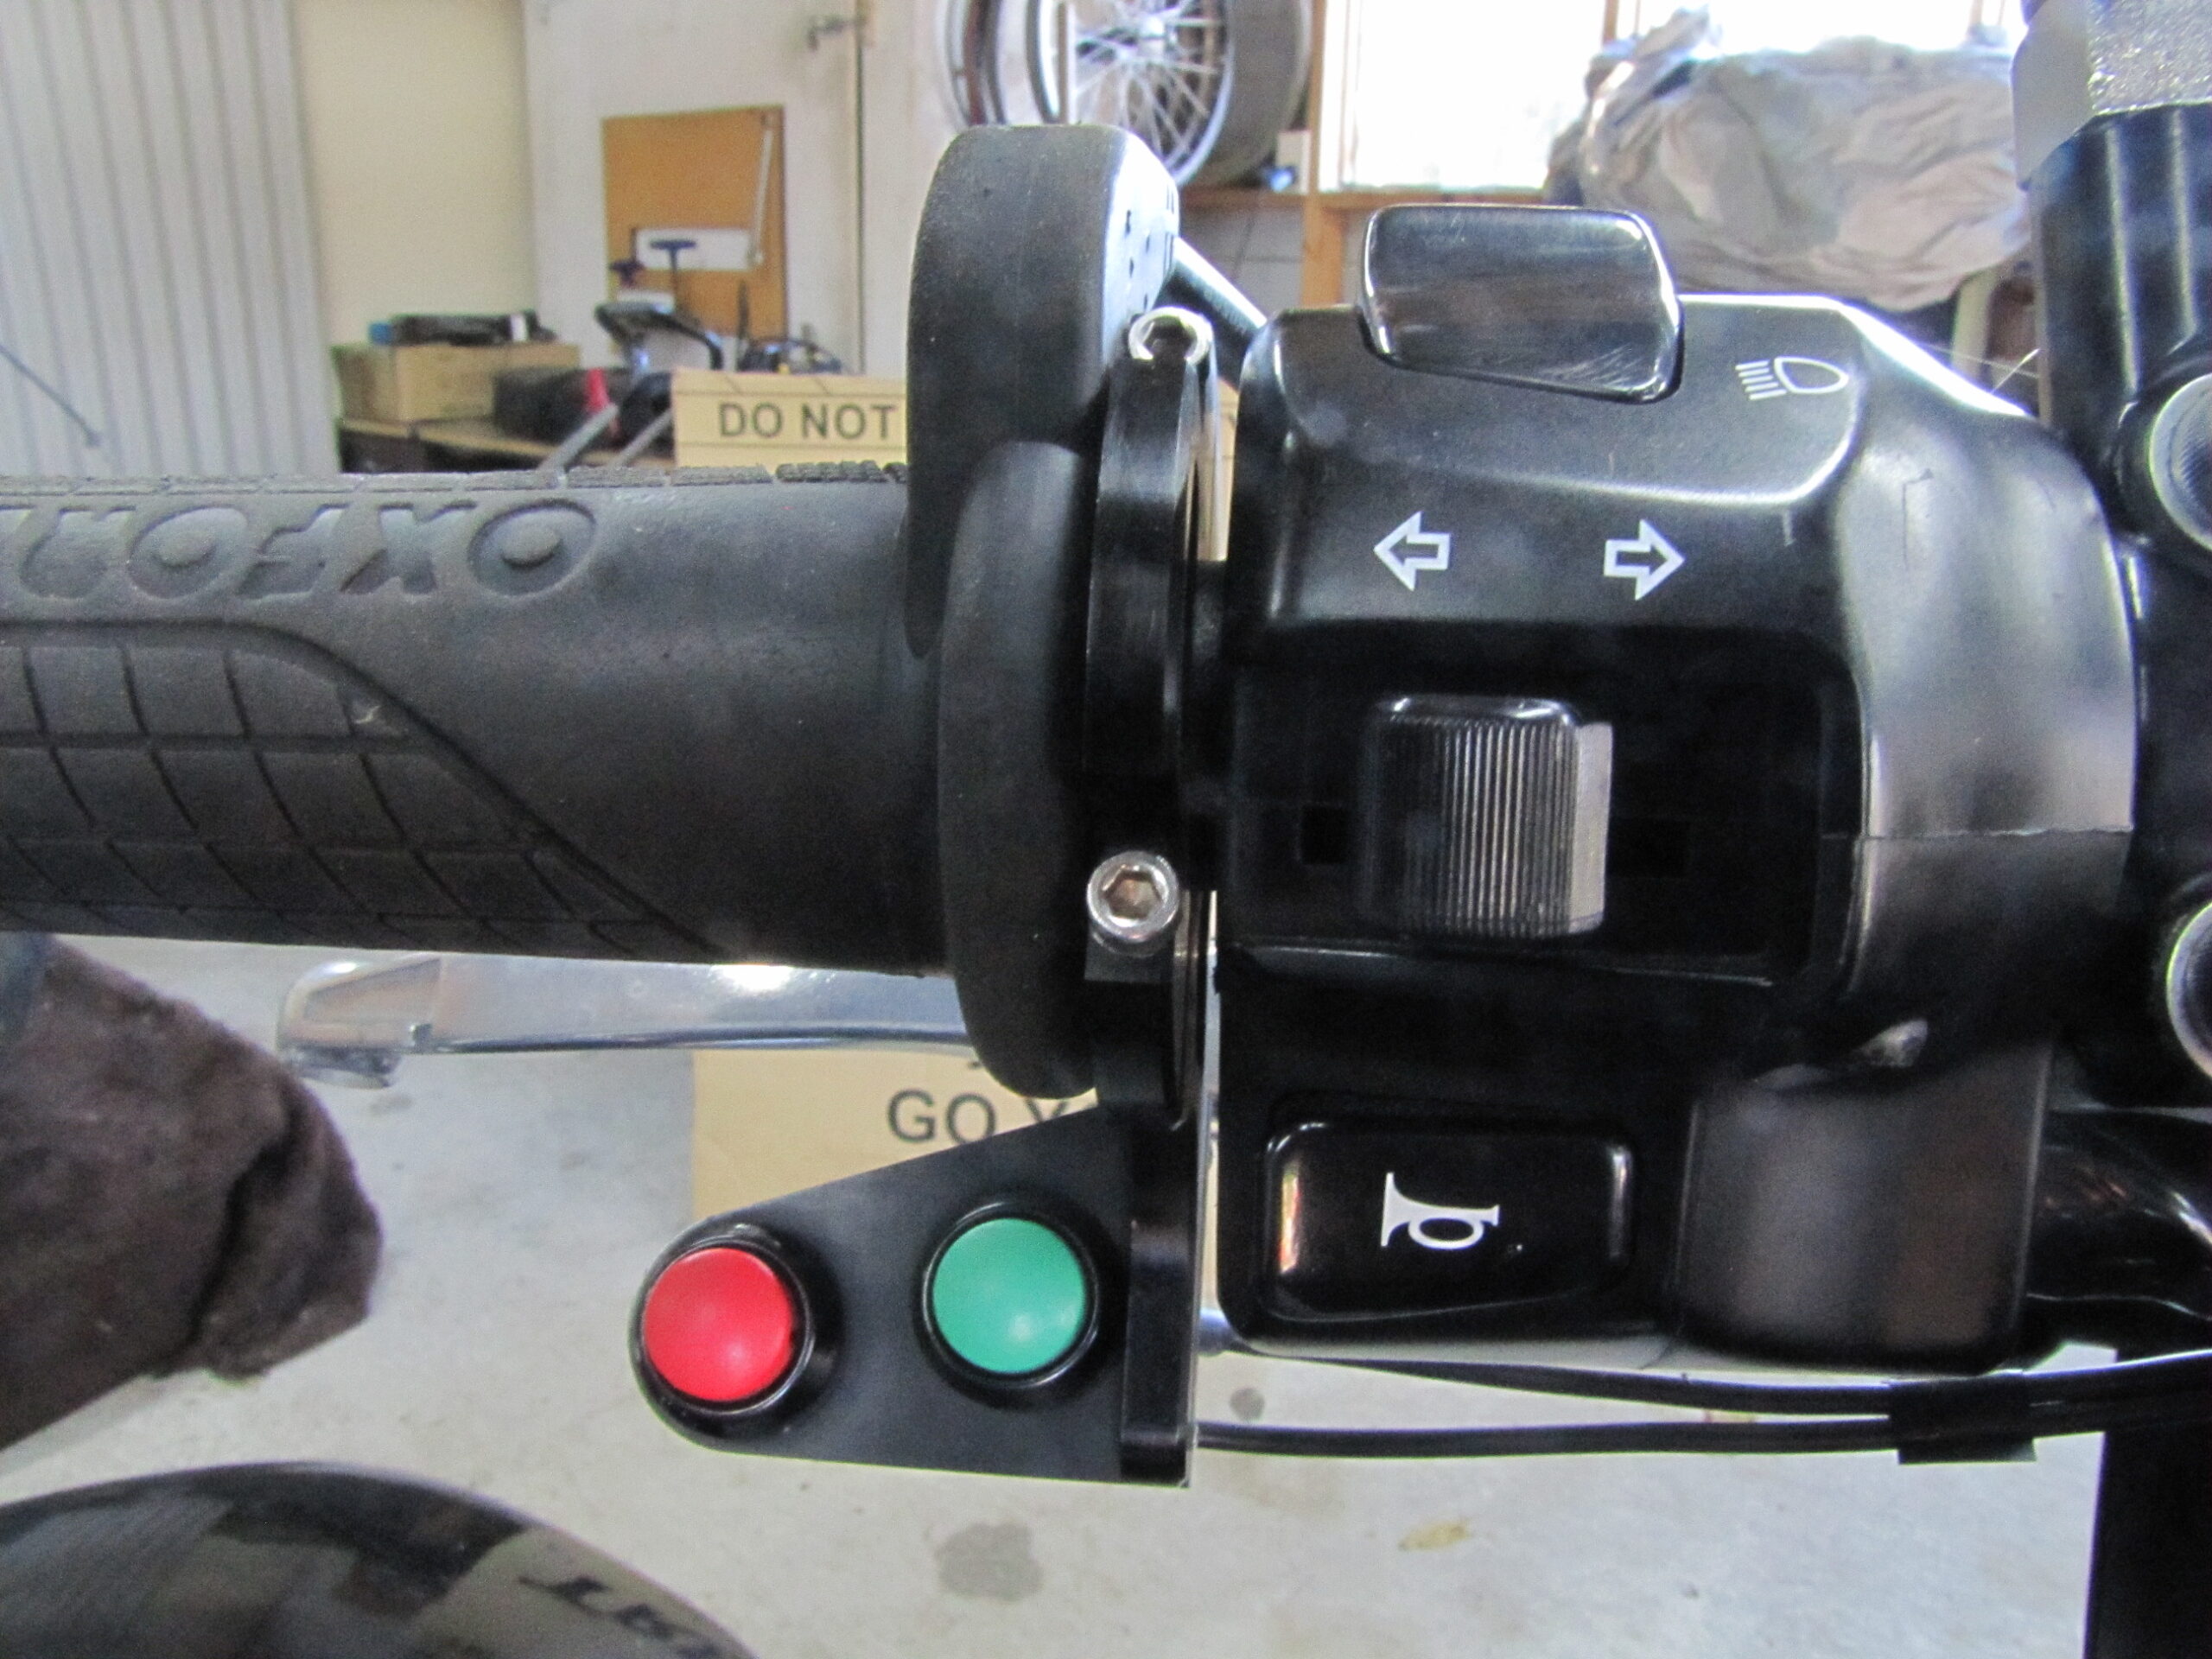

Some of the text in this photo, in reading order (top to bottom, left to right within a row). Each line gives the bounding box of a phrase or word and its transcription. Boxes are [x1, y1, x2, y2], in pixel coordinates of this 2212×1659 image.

[719, 402, 896, 439] DO NOT
[0, 499, 598, 598] OXFOR
[887, 1088, 997, 1144] GO
